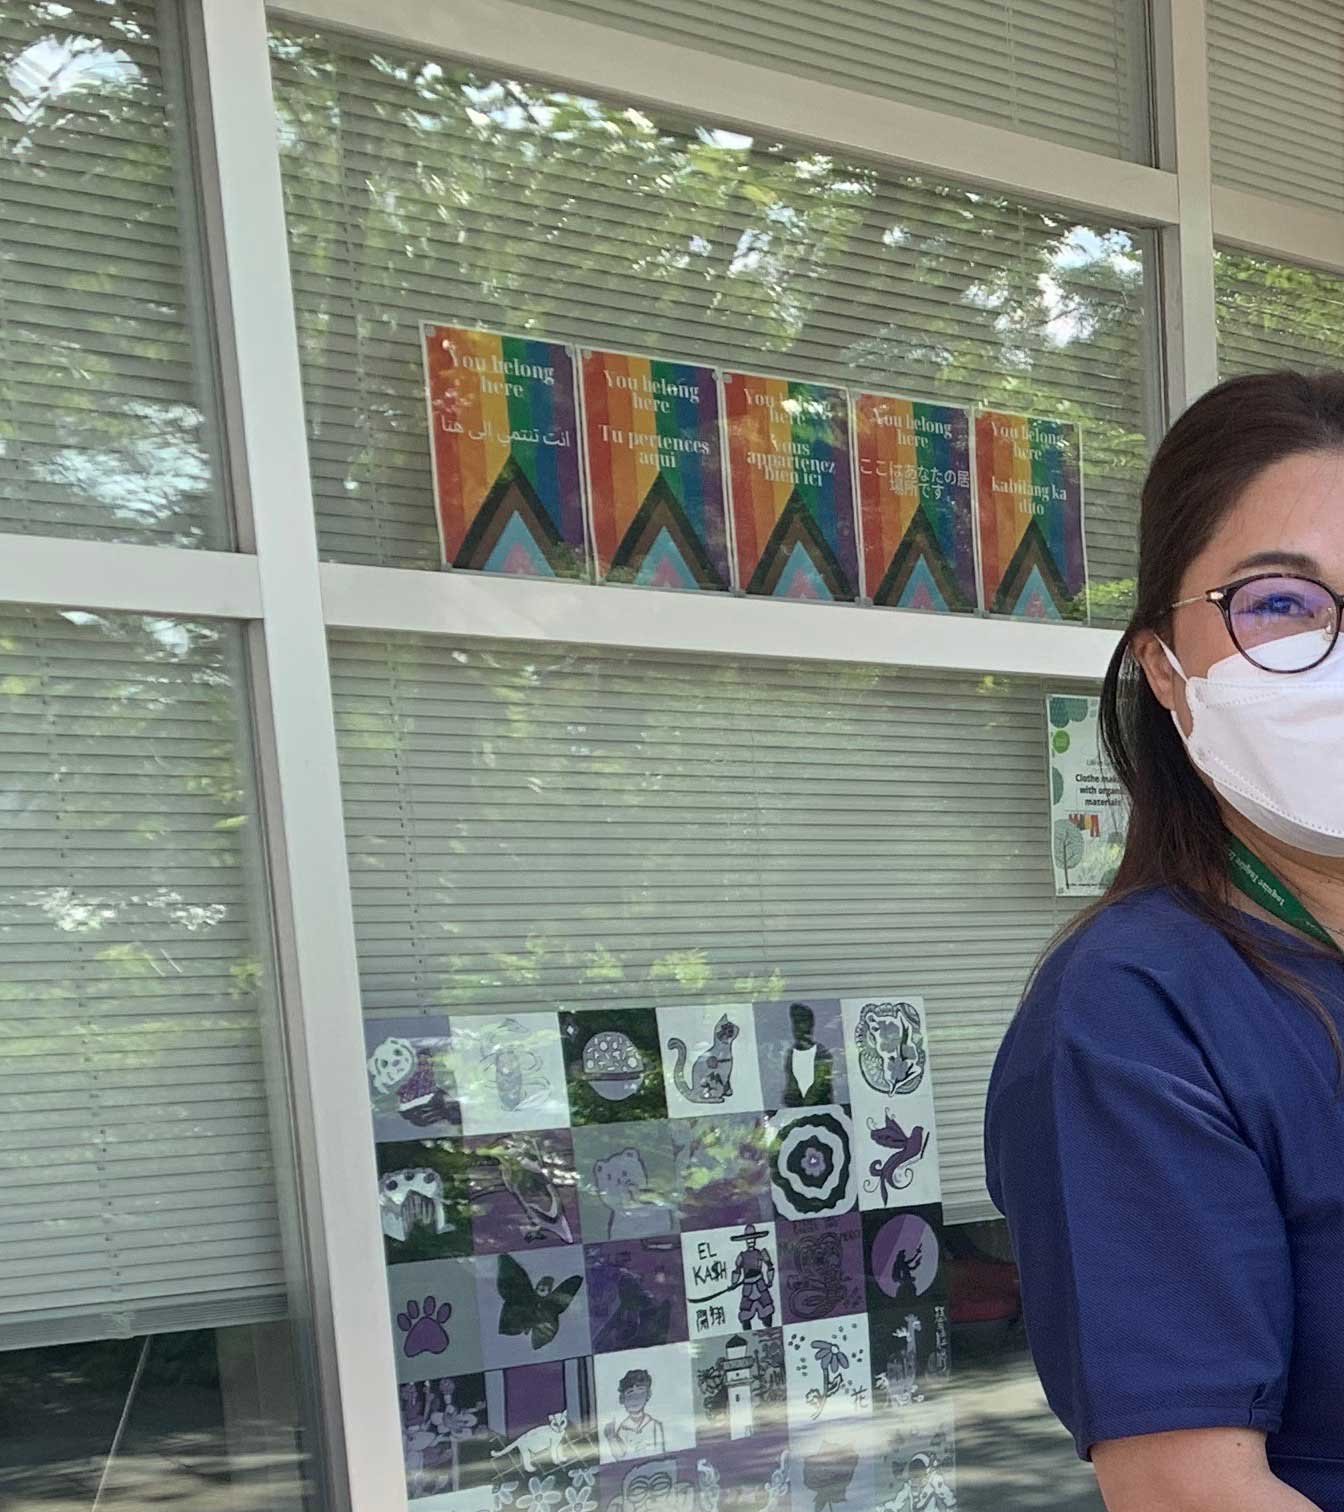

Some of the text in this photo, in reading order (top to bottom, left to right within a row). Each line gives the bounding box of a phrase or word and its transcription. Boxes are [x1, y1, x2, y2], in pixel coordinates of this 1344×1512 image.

[447, 345, 555, 386] You belong
[481, 376, 524, 398] here
[603, 369, 700, 404] You belong
[743, 388, 775, 409] You
[632, 391, 671, 414] here
[873, 405, 953, 440] You belong
[598, 424, 710, 455] Tu pertences
[896, 428, 930, 449] here
[991, 421, 1065, 450] You belong
[746, 450, 836, 475] appartenez
[1013, 440, 1043, 461] here
[991, 475, 1067, 503] kabilang ka
[697, 1242, 718, 1261] EL
